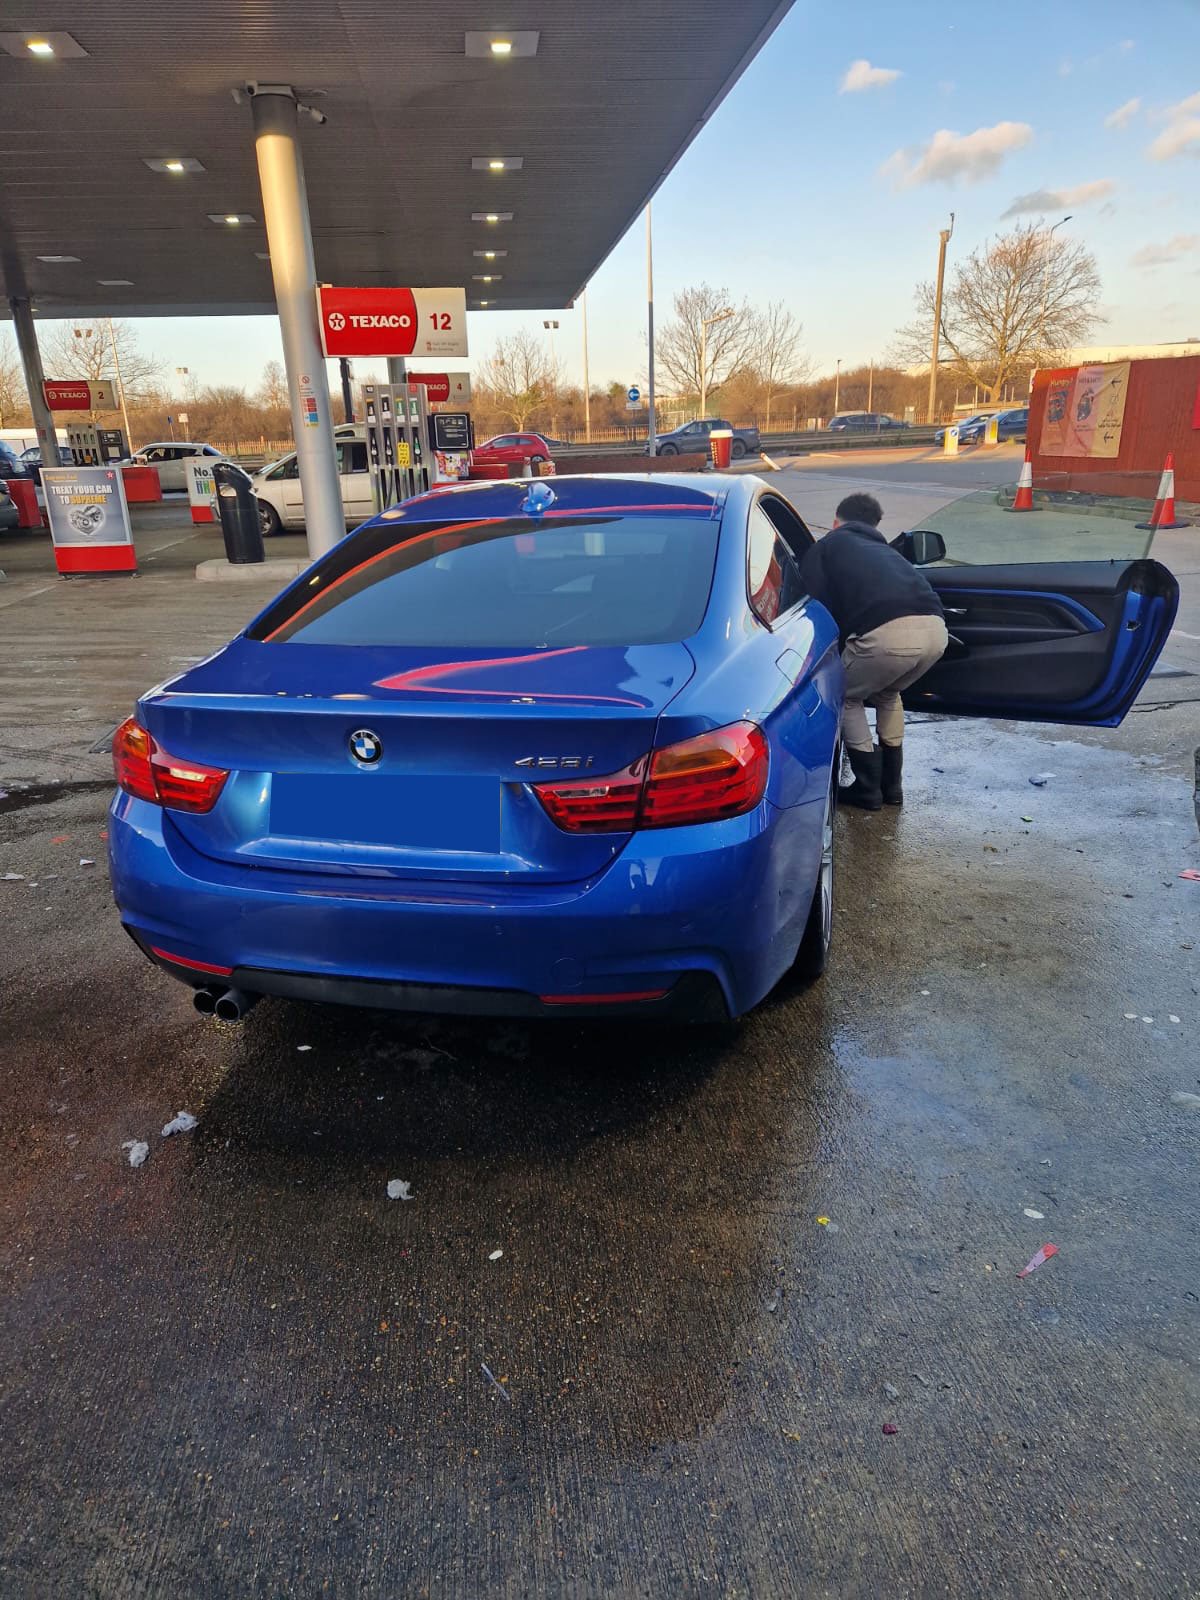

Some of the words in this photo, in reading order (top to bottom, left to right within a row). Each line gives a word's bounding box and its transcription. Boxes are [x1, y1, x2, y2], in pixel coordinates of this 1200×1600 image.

[349, 315, 411, 328] TEXACO
[429, 312, 452, 331] 12
[58, 391, 87, 399] TEXACO
[97, 391, 104, 400] 2
[51, 486, 73, 495] TREAT
[74, 485, 95, 494] YOUR
[95, 484, 113, 494] CAR
[60, 495, 70, 505] TO
